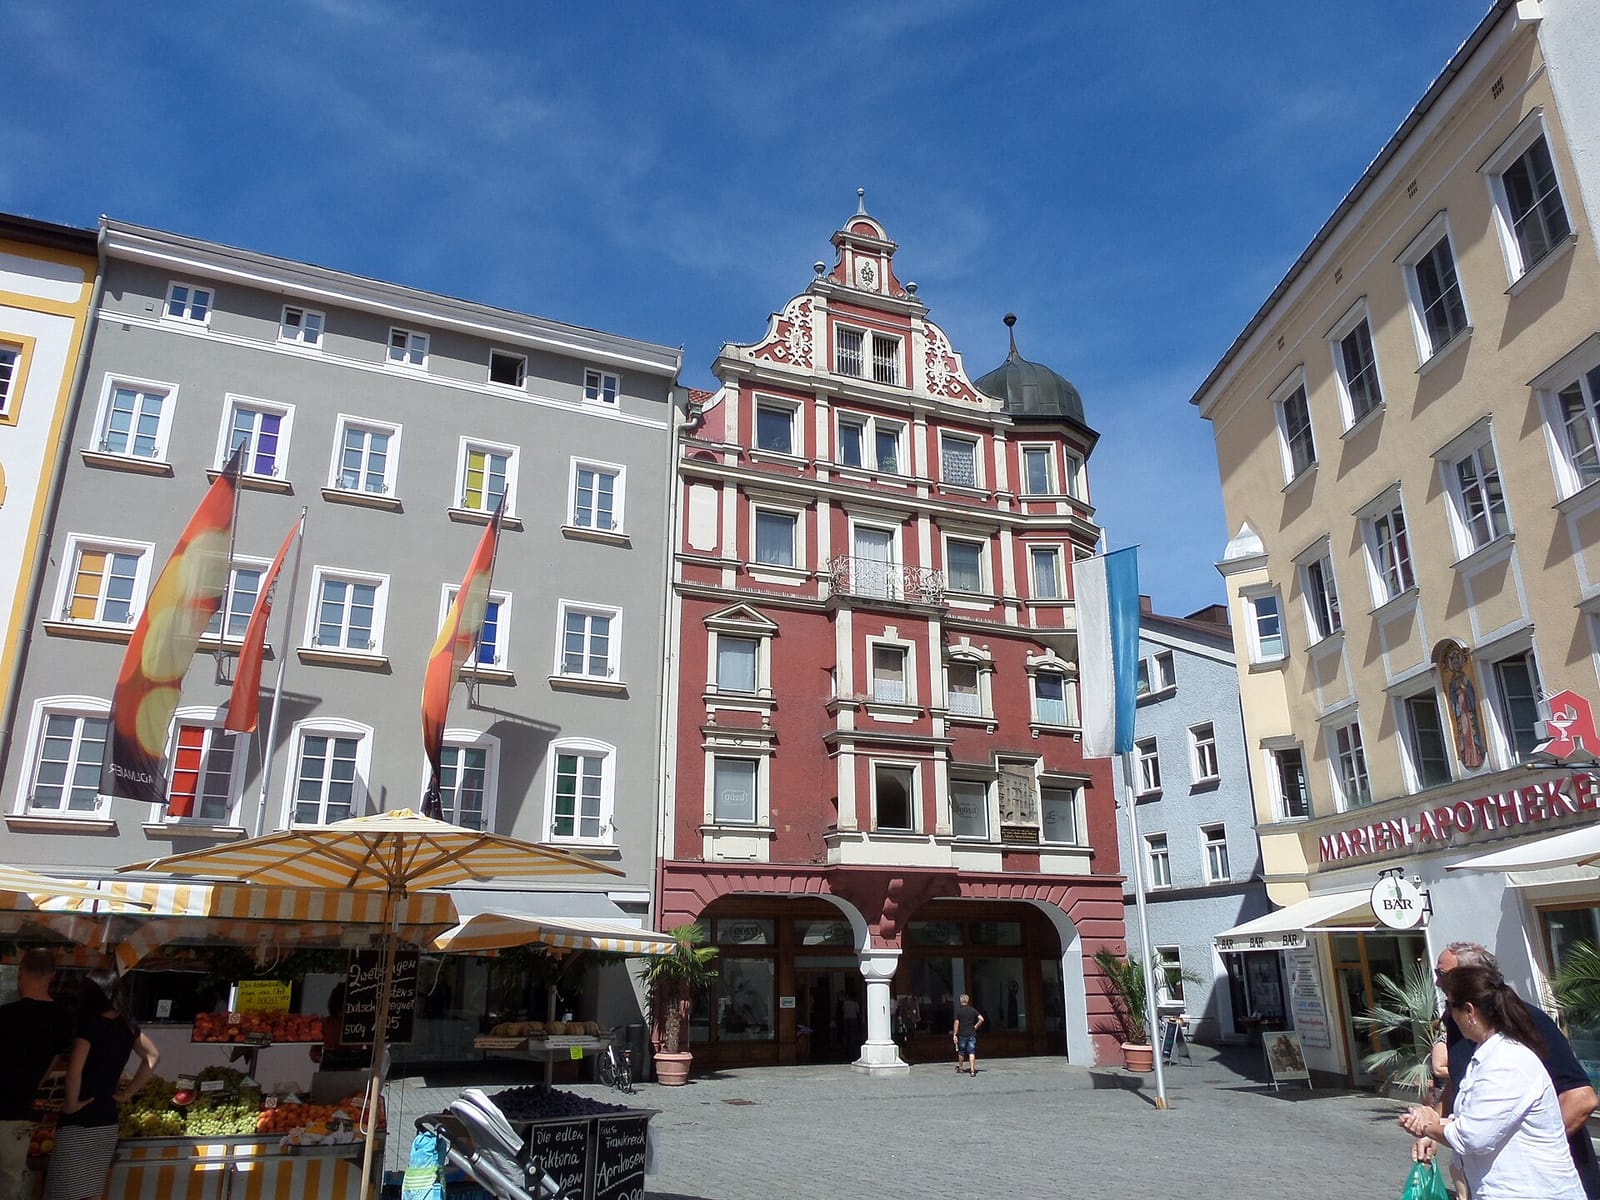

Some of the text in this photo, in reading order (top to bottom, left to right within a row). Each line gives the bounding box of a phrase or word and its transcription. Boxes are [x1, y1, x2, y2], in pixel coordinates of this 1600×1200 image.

[1319, 772, 1600, 863] MARIEN-APOTHEKE
[536, 1126, 584, 1144] Die edlen
[605, 1128, 646, 1149] Frankreich
[597, 1152, 645, 1189] Aprikosen
